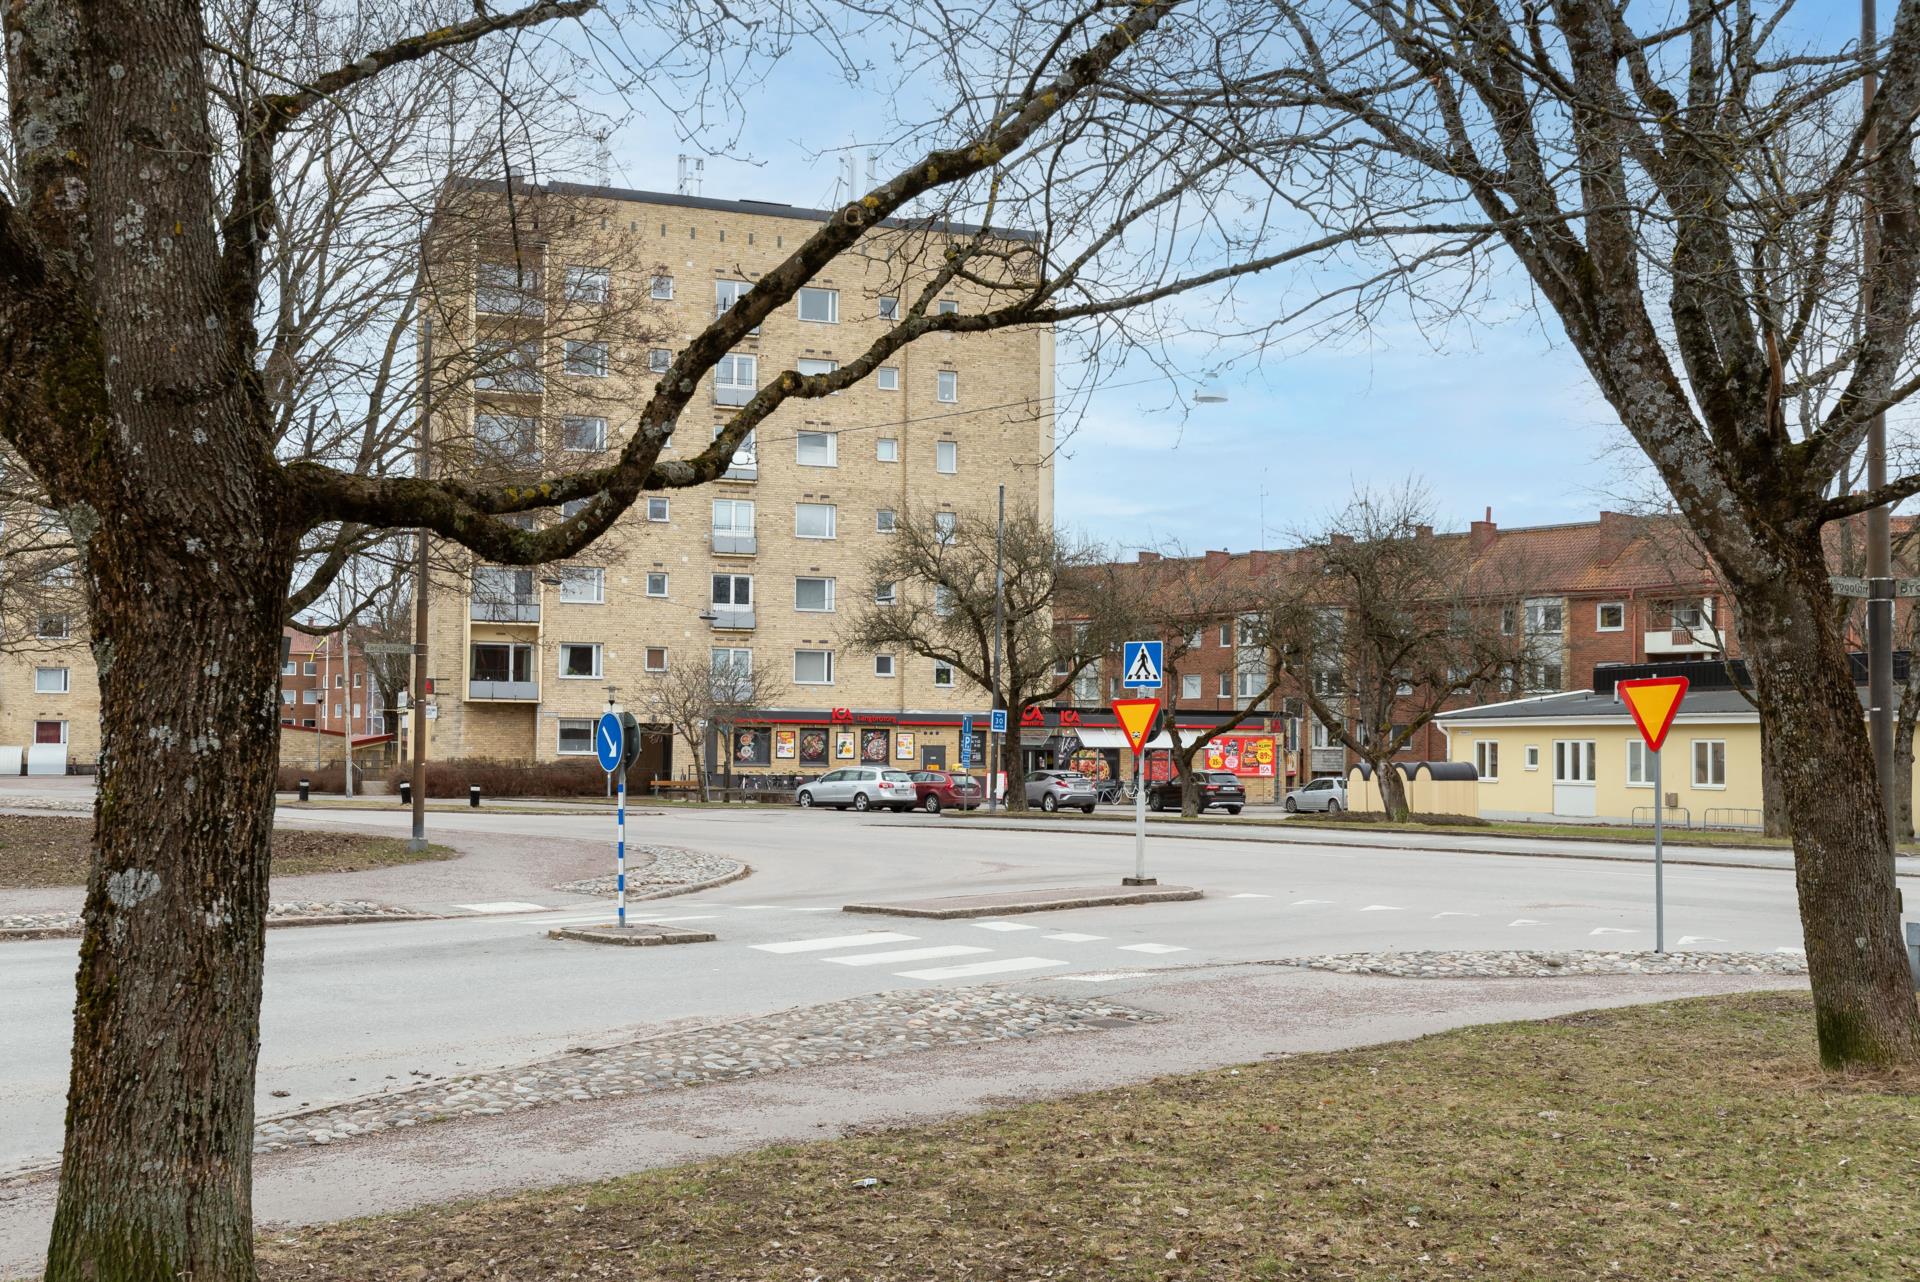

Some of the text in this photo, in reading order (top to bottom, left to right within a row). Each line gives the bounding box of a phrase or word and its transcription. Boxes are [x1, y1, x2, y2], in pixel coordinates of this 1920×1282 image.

[832, 708, 854, 721] ICA
[1022, 705, 1044, 721] CA
[1059, 710, 1081, 722] ICA
